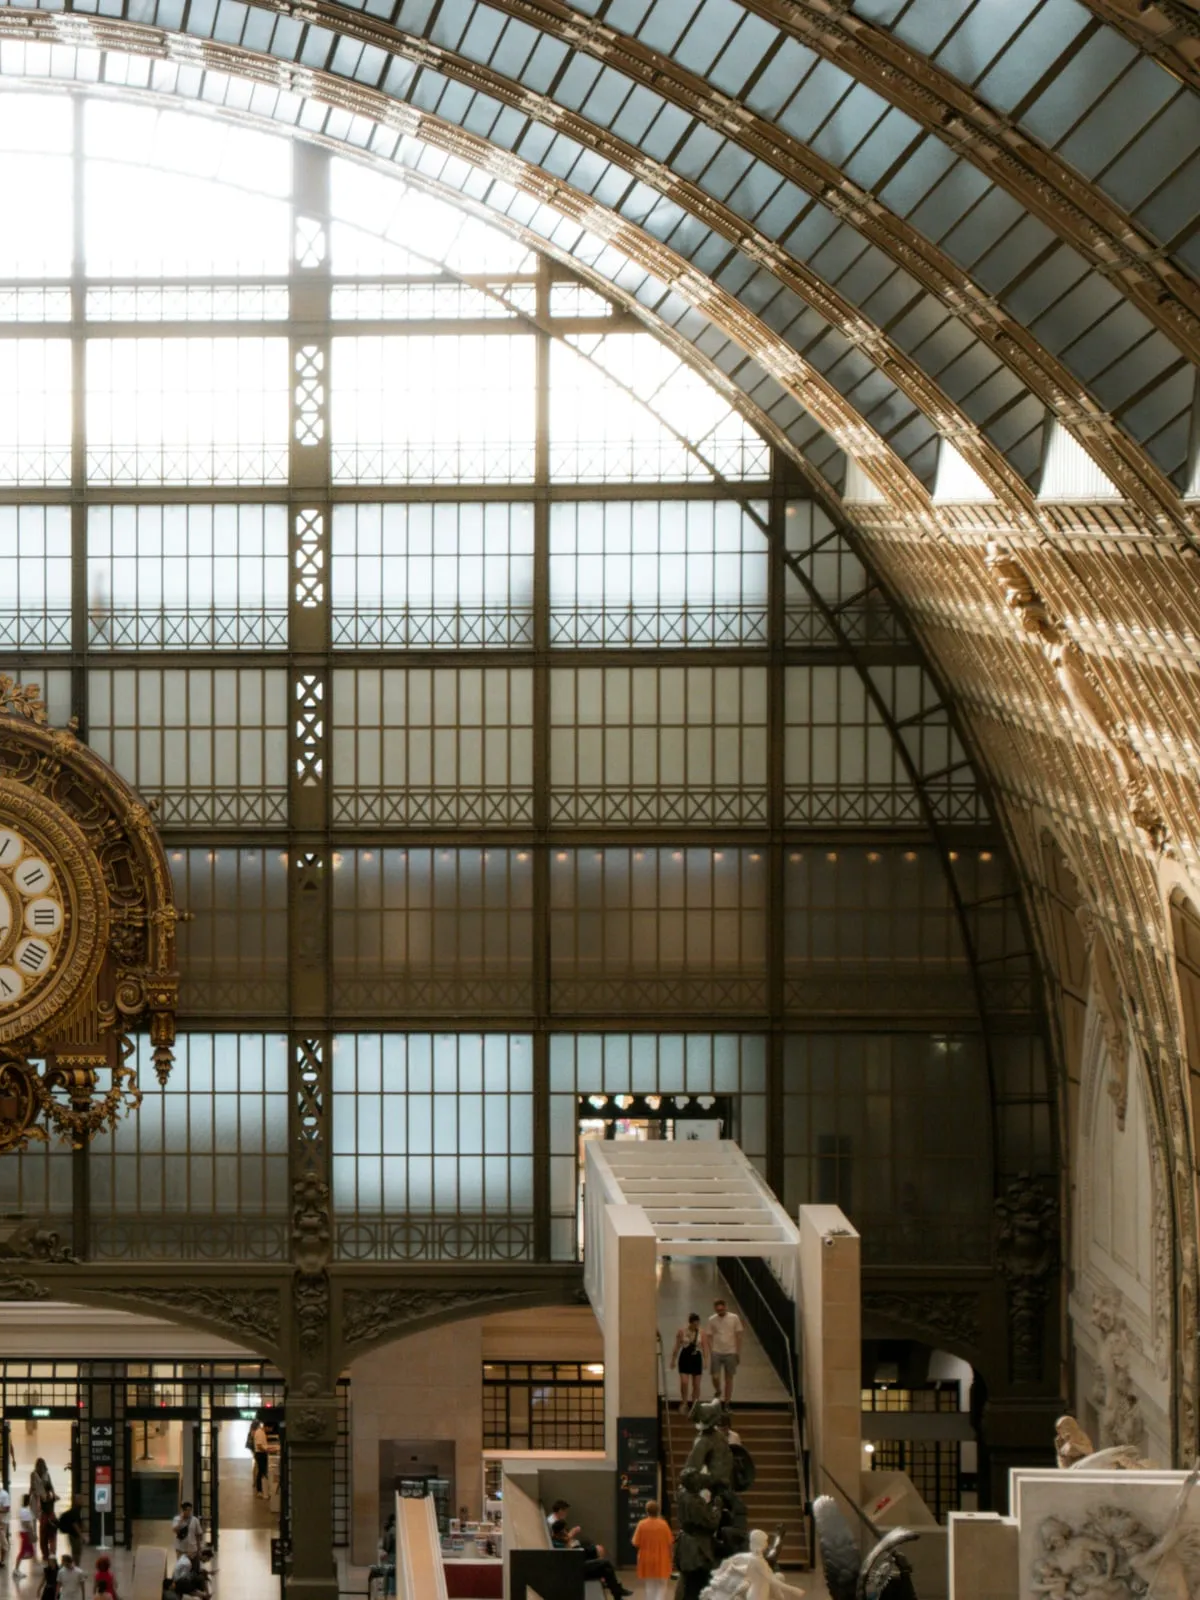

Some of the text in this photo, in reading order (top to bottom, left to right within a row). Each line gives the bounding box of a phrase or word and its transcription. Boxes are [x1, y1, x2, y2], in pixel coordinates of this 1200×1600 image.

[24, 868, 44, 886] II
[34, 908, 54, 925] III
[20, 942, 47, 970] IIII
[0, 977, 14, 996] V
